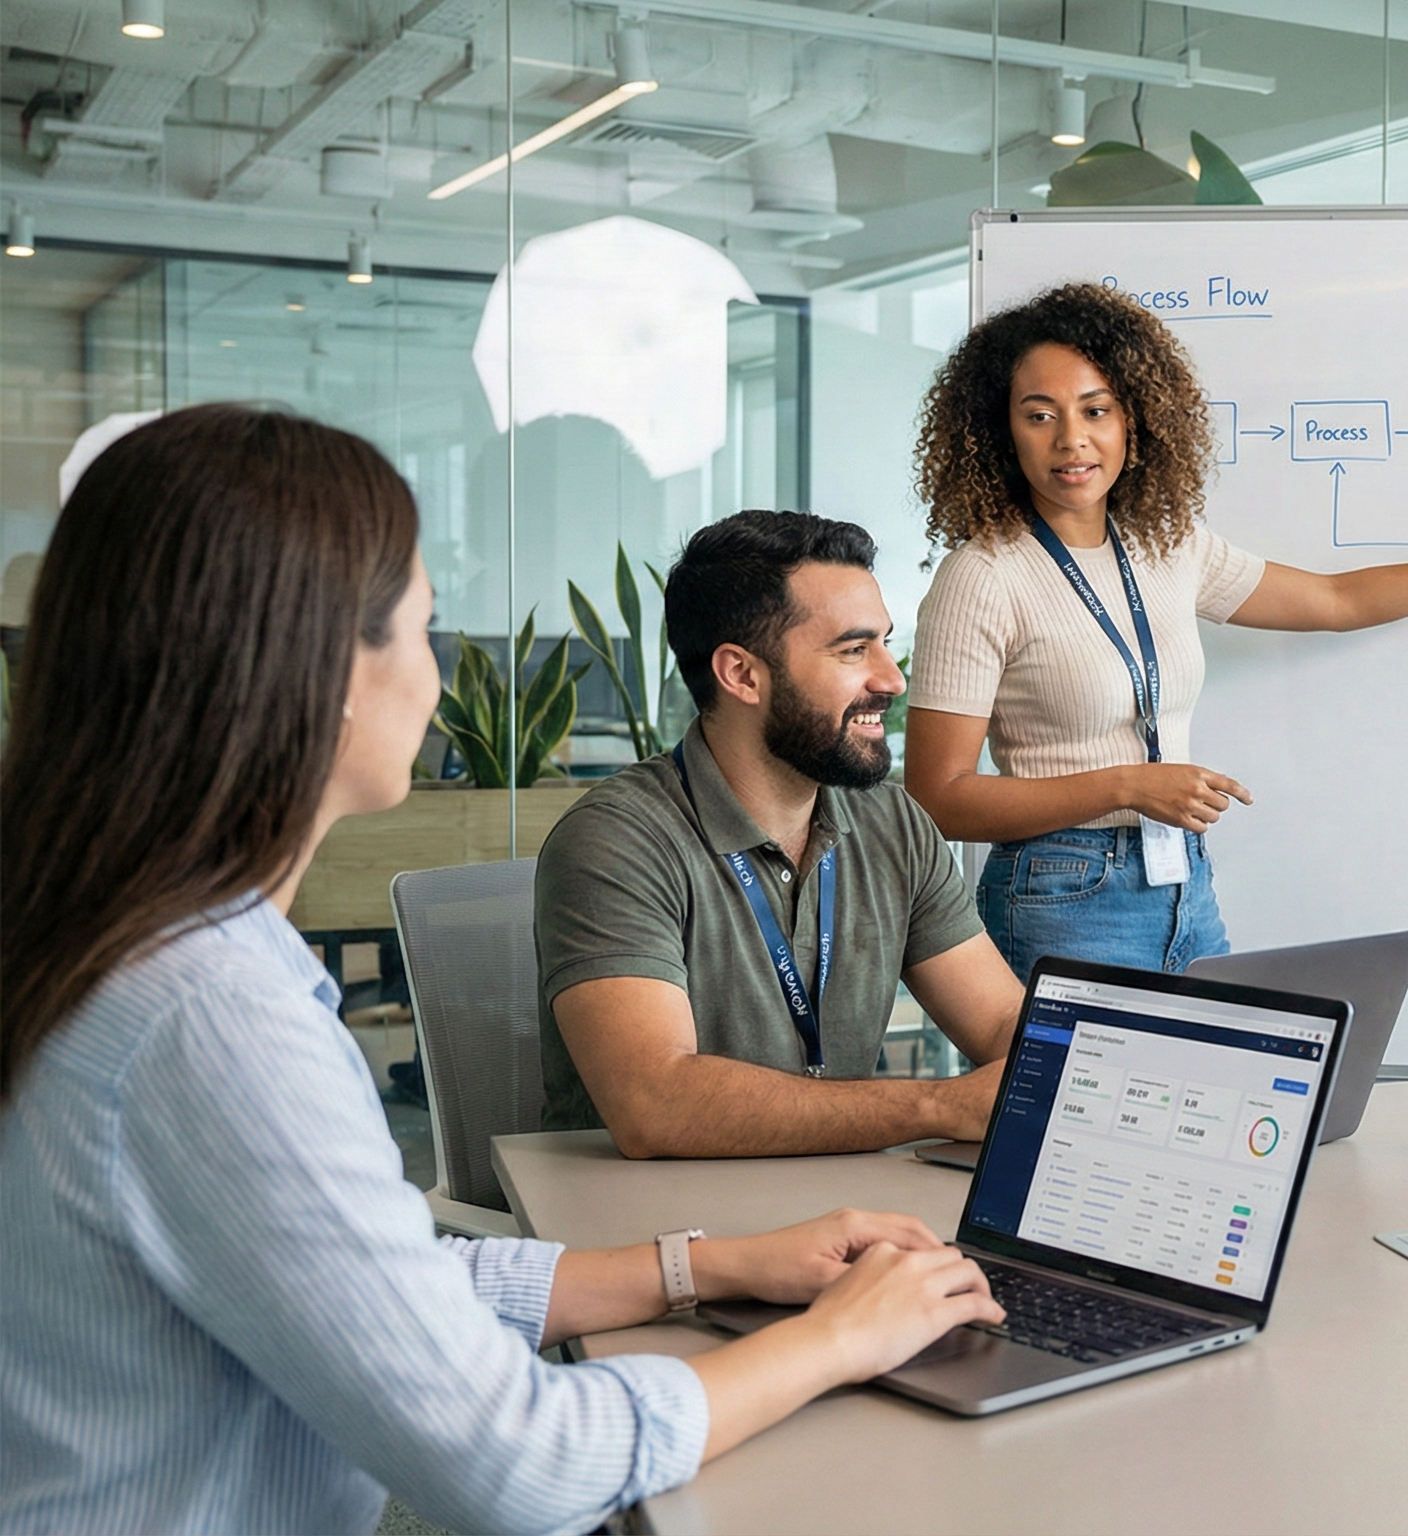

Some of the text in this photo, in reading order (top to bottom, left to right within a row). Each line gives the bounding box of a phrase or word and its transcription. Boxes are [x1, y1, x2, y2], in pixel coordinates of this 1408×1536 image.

[1101, 274, 1269, 310] Pocess Flow
[1305, 419, 1369, 441] Process
